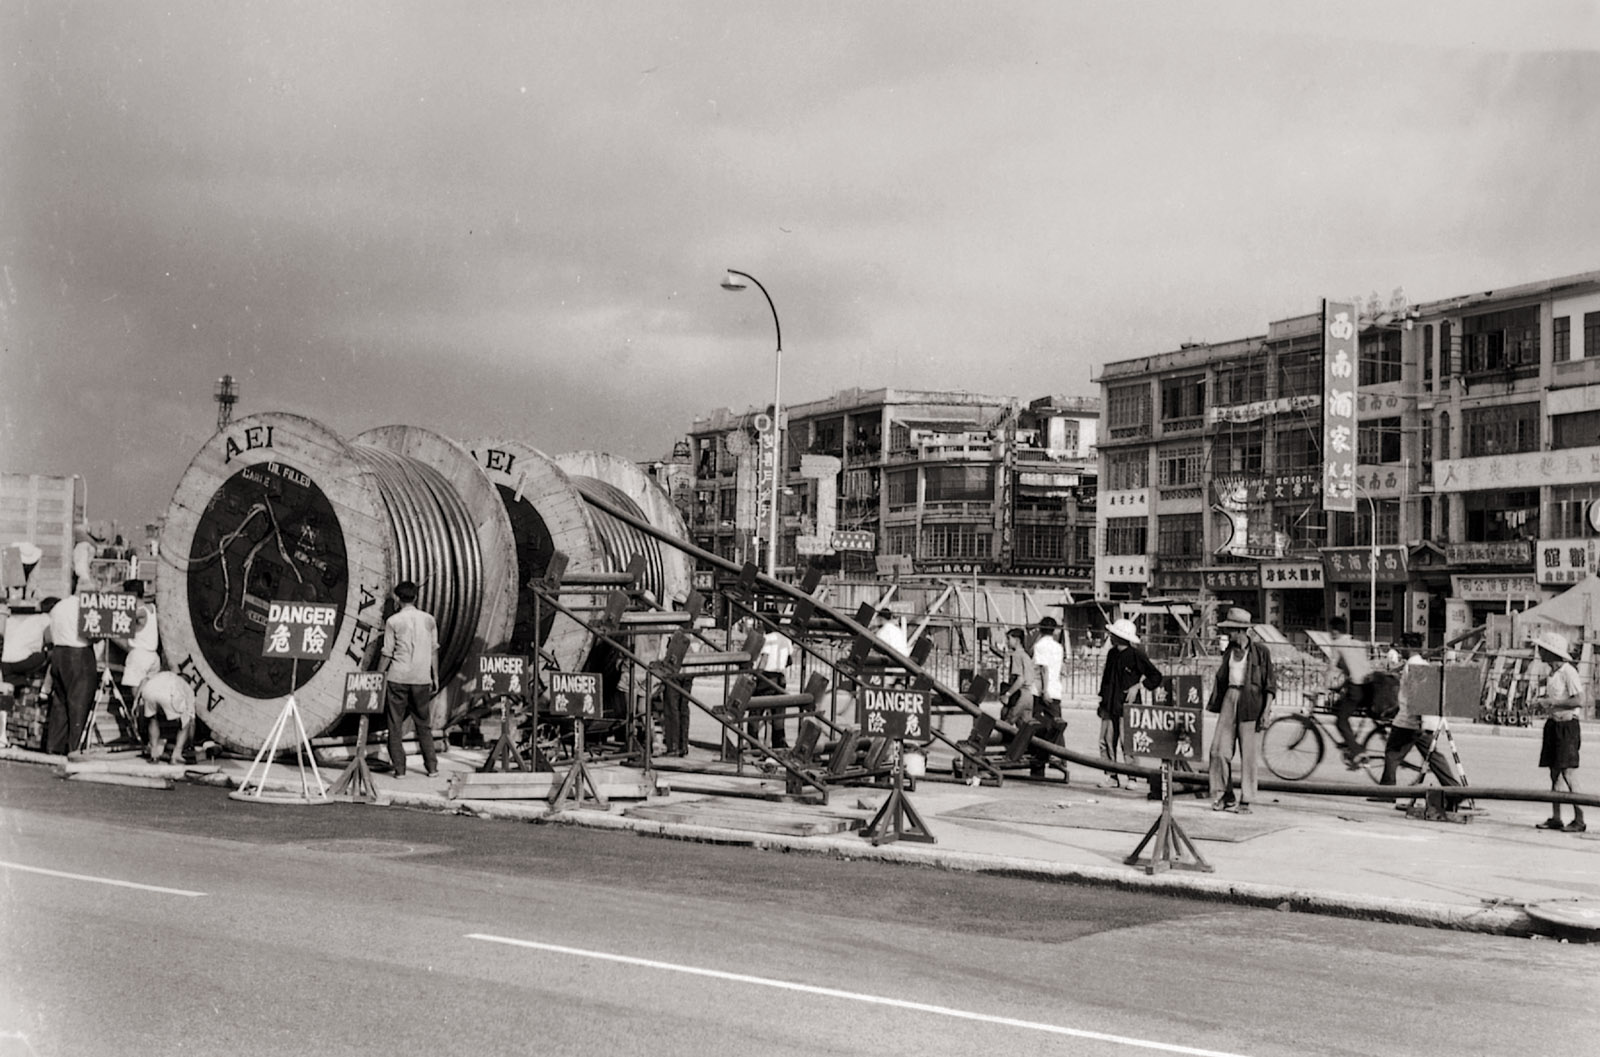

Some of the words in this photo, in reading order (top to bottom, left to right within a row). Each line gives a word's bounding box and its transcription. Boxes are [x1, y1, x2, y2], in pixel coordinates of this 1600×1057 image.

[1329, 311, 1353, 454] 西南酒家
[224, 426, 275, 464] AEI
[267, 461, 282, 476] OIL
[282, 467, 312, 488] FILLED
[471, 449, 516, 476] EI
[1331, 552, 1397, 572] 西南酒家
[80, 592, 136, 611] DANGER
[83, 609, 133, 634] 危險
[268, 604, 336, 626] DANGER
[345, 584, 376, 667] AEI
[267, 624, 328, 654] 危險
[480, 656, 523, 675] DANGER
[177, 654, 225, 714] AEI
[346, 673, 384, 691] DANGER
[553, 674, 596, 694] DANGER
[865, 689, 924, 714] DANGER
[1129, 707, 1196, 733] DANGER
